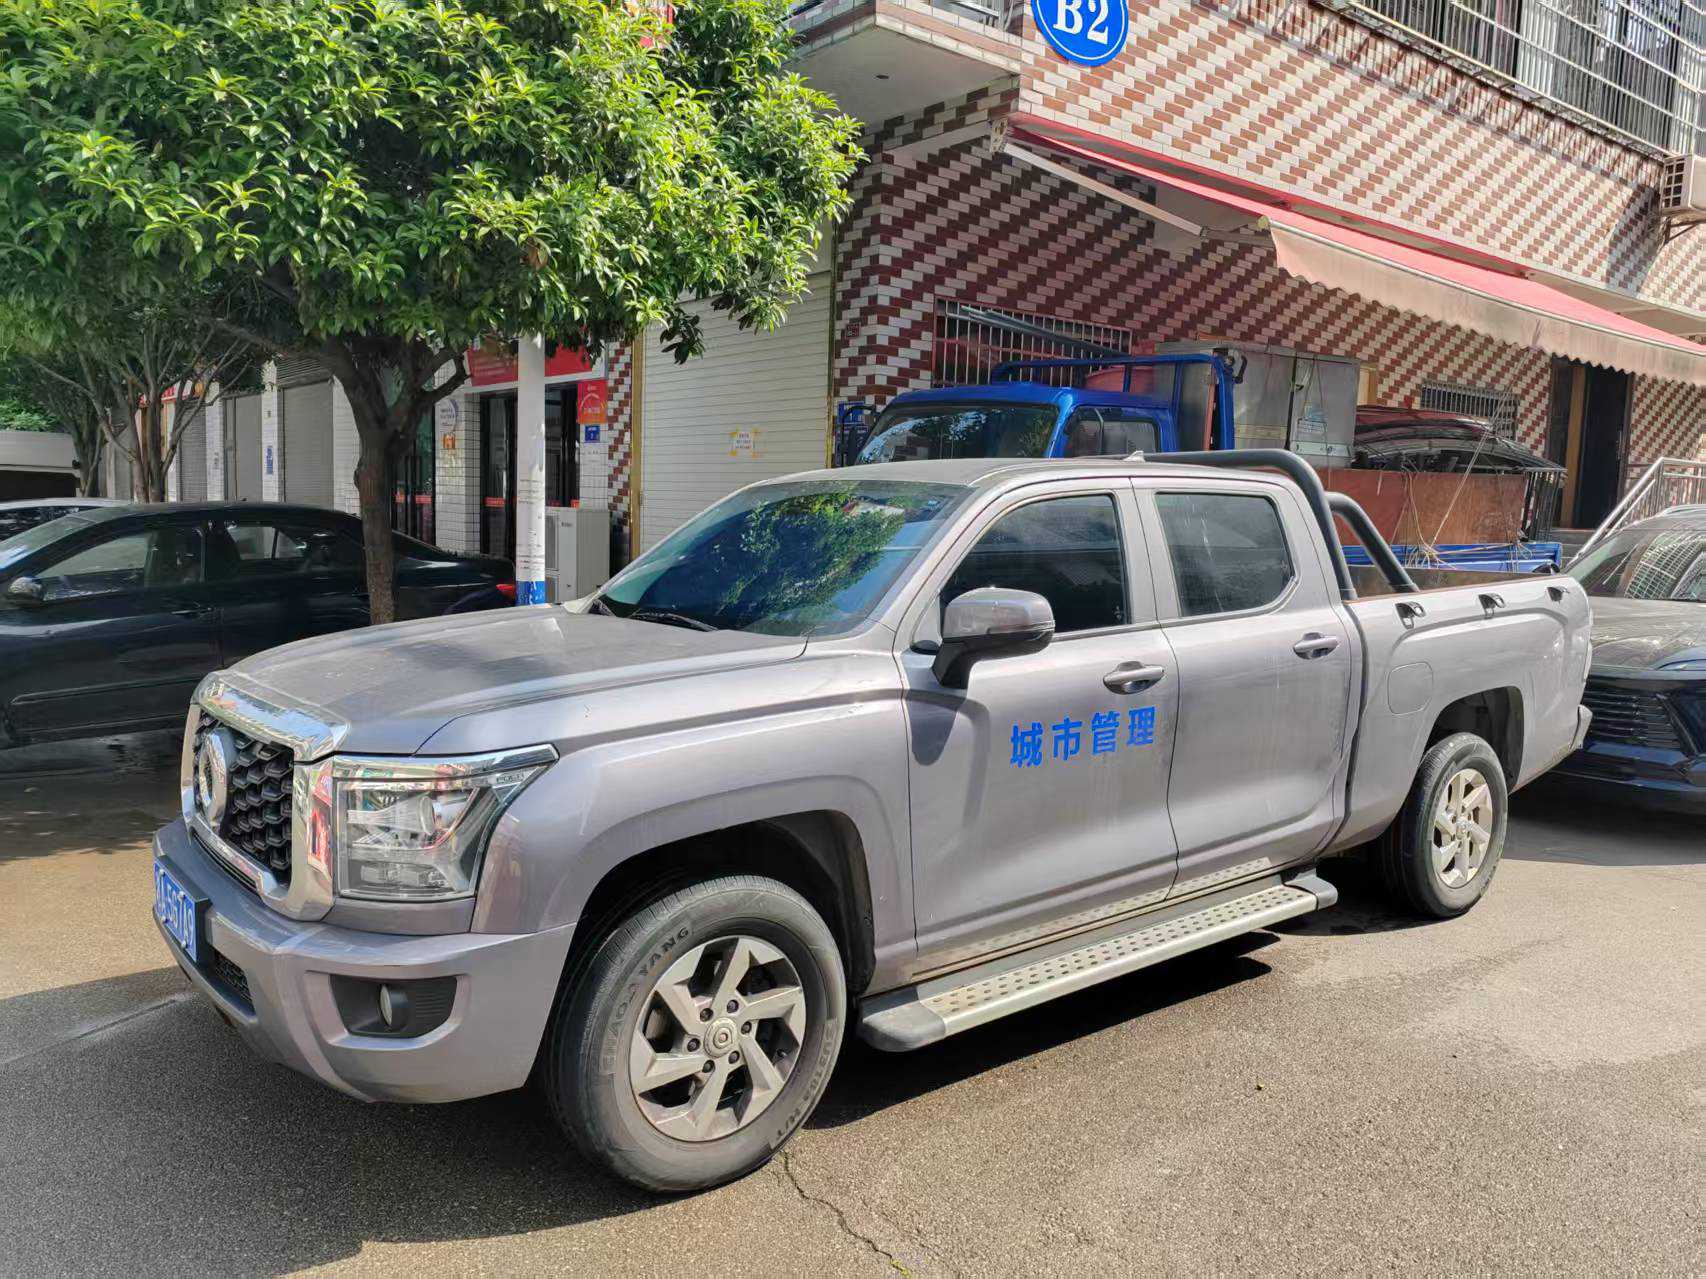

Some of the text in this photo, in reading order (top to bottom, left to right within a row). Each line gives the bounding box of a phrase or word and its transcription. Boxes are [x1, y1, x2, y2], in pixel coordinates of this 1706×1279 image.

[1053, 0, 1109, 45] B2
[1010, 706, 1156, 768] 城市管理
